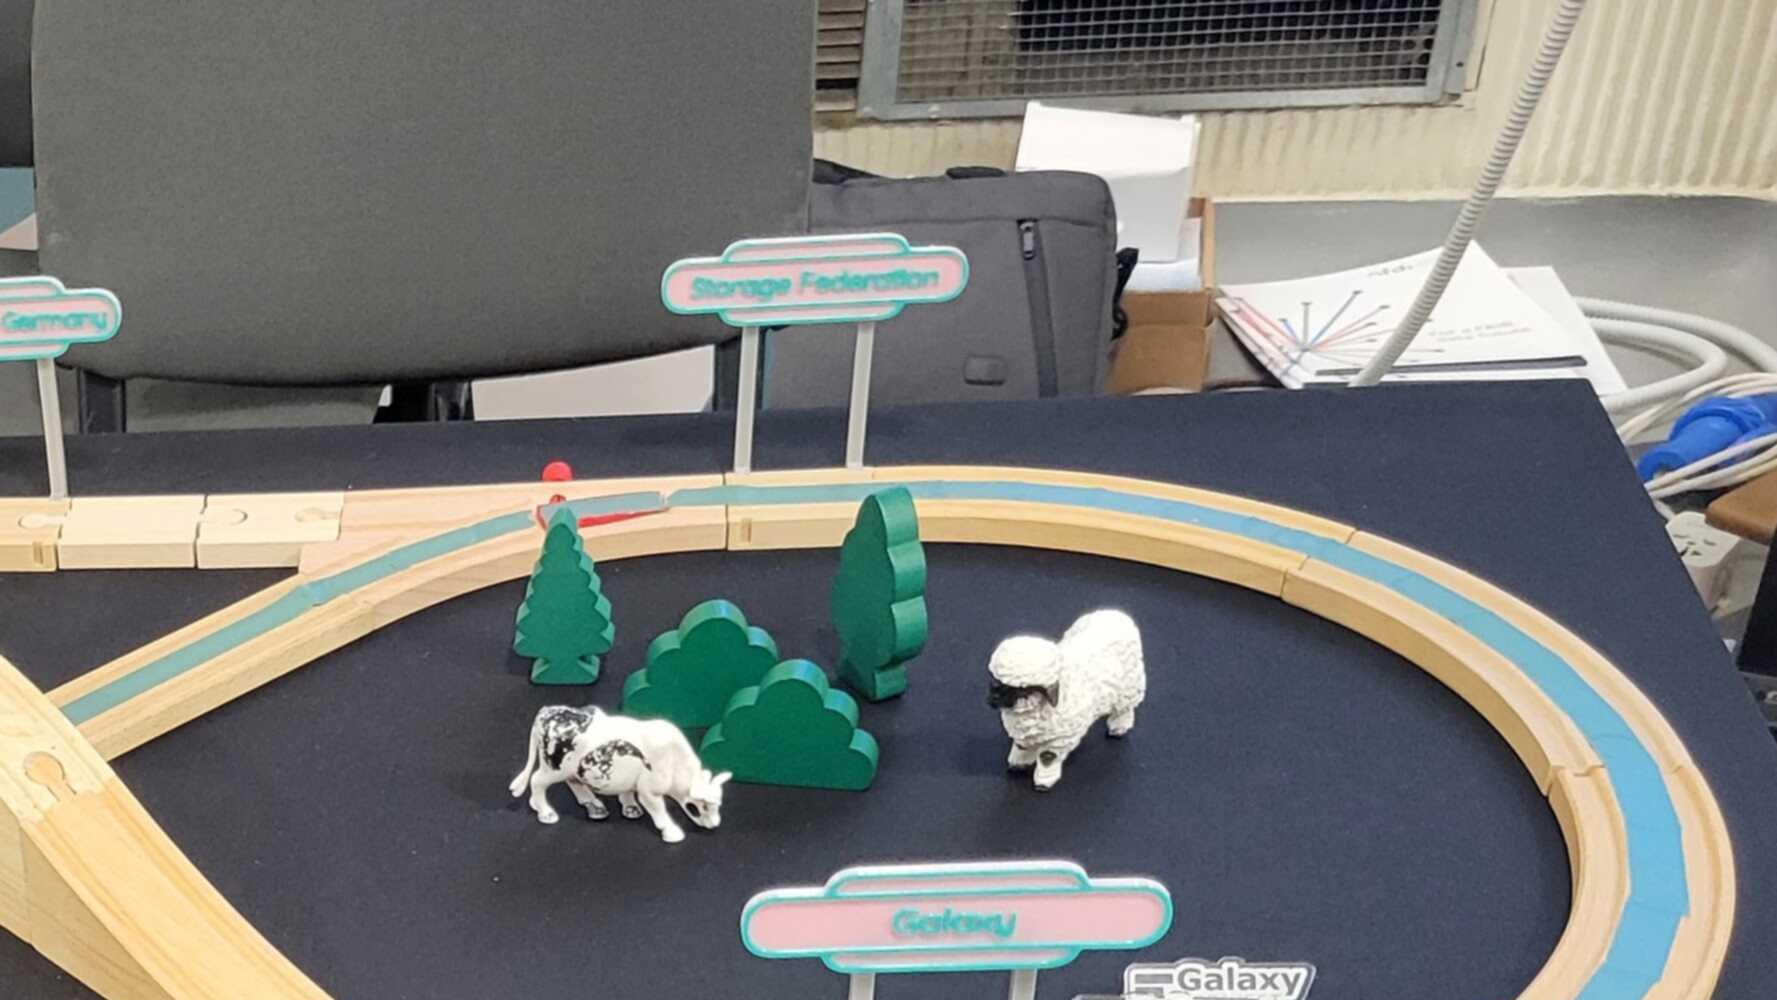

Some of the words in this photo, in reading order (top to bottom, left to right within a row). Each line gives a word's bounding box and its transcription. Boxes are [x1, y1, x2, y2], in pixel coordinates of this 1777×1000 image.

[691, 276, 791, 300] Storage
[799, 269, 940, 294] Federation
[1, 311, 107, 331] Germany
[891, 907, 1017, 938] Galaxy
[1178, 964, 1302, 996] Galaxy
